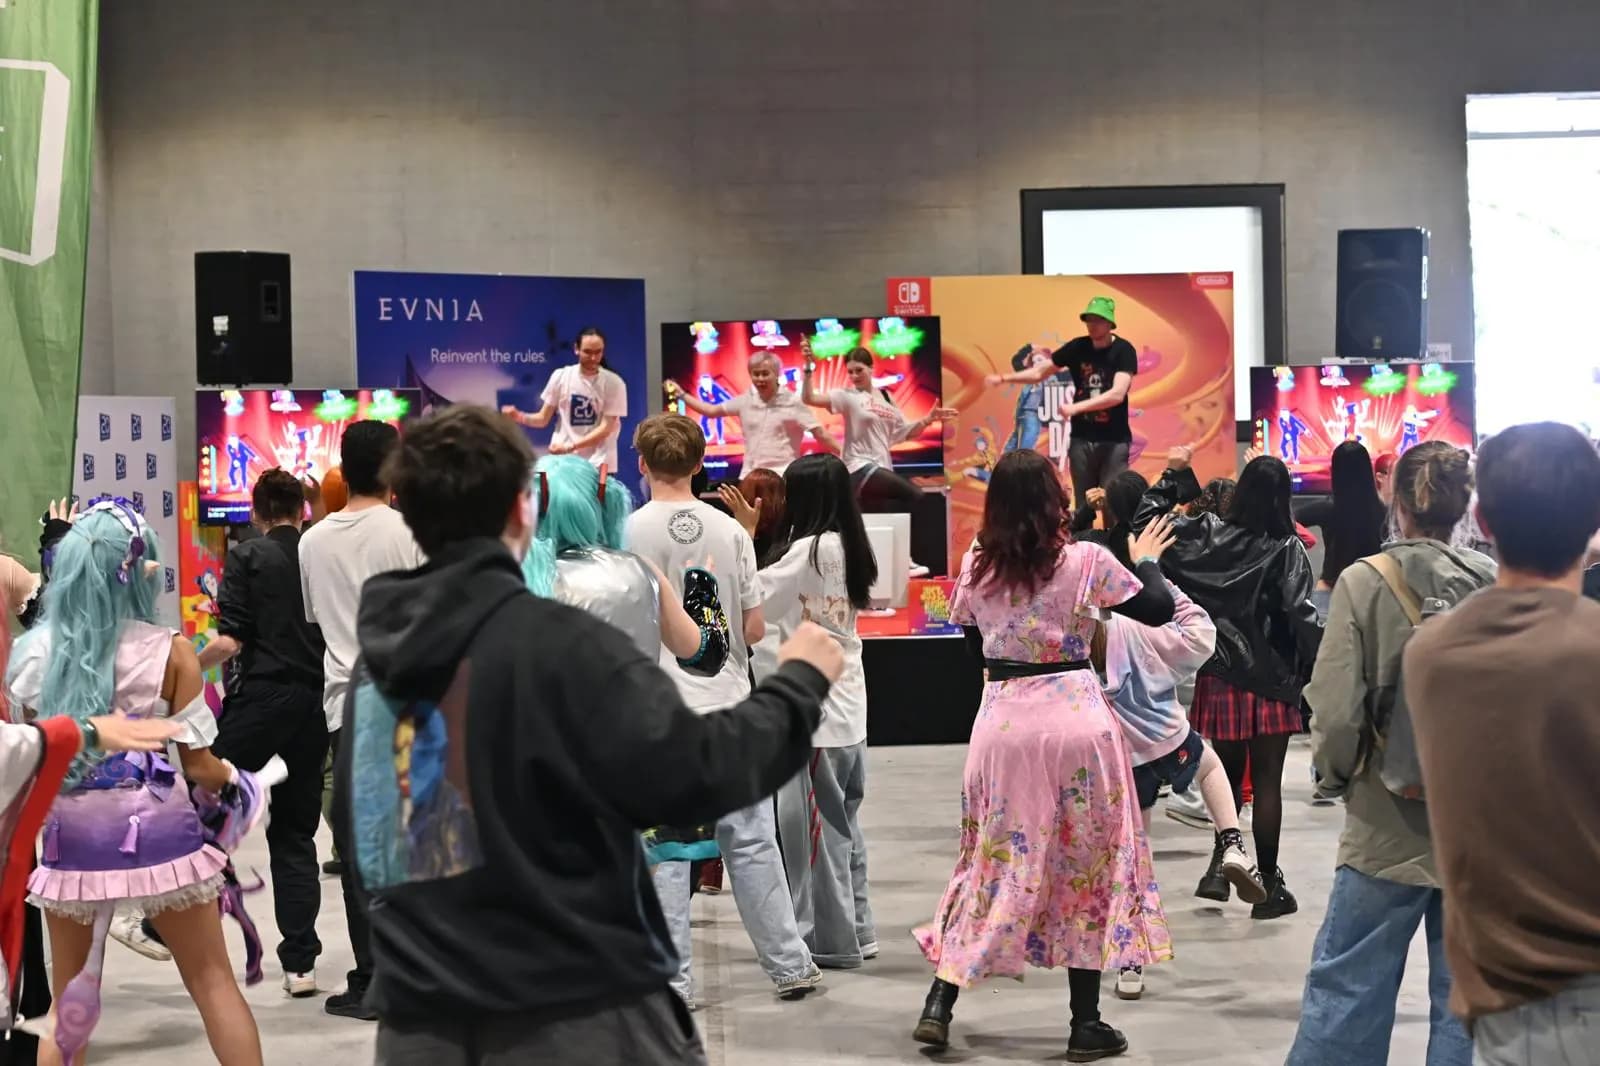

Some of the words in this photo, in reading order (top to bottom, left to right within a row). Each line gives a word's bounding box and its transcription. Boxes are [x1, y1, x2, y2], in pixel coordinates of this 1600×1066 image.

[378, 297, 484, 322] EVNIA
[430, 348, 487, 364] Reinvent
[490, 348, 511, 364] the
[1037, 386, 1076, 422] JUS
